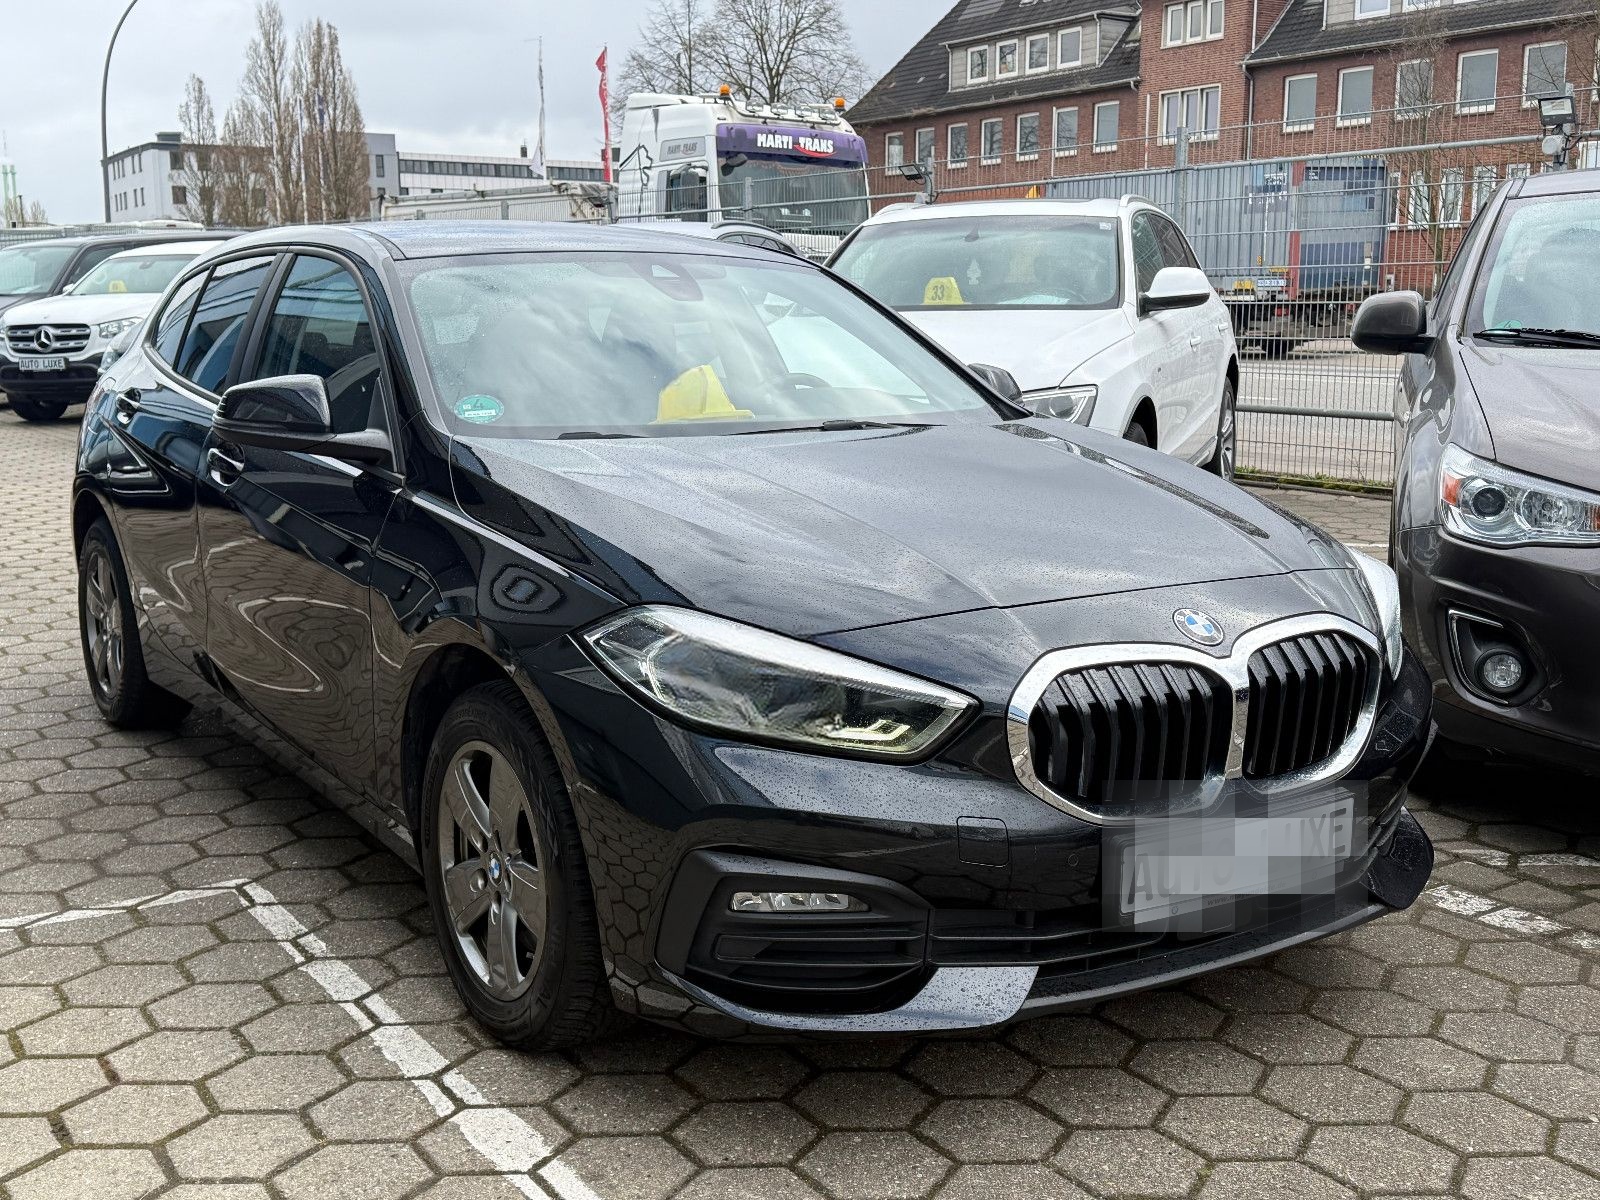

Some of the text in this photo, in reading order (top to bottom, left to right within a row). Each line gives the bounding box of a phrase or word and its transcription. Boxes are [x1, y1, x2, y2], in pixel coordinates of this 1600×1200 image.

[757, 133, 834, 155] MARTI TRANS
[932, 285, 944, 301] 33
[20, 359, 63, 369] AUTO LUXE
